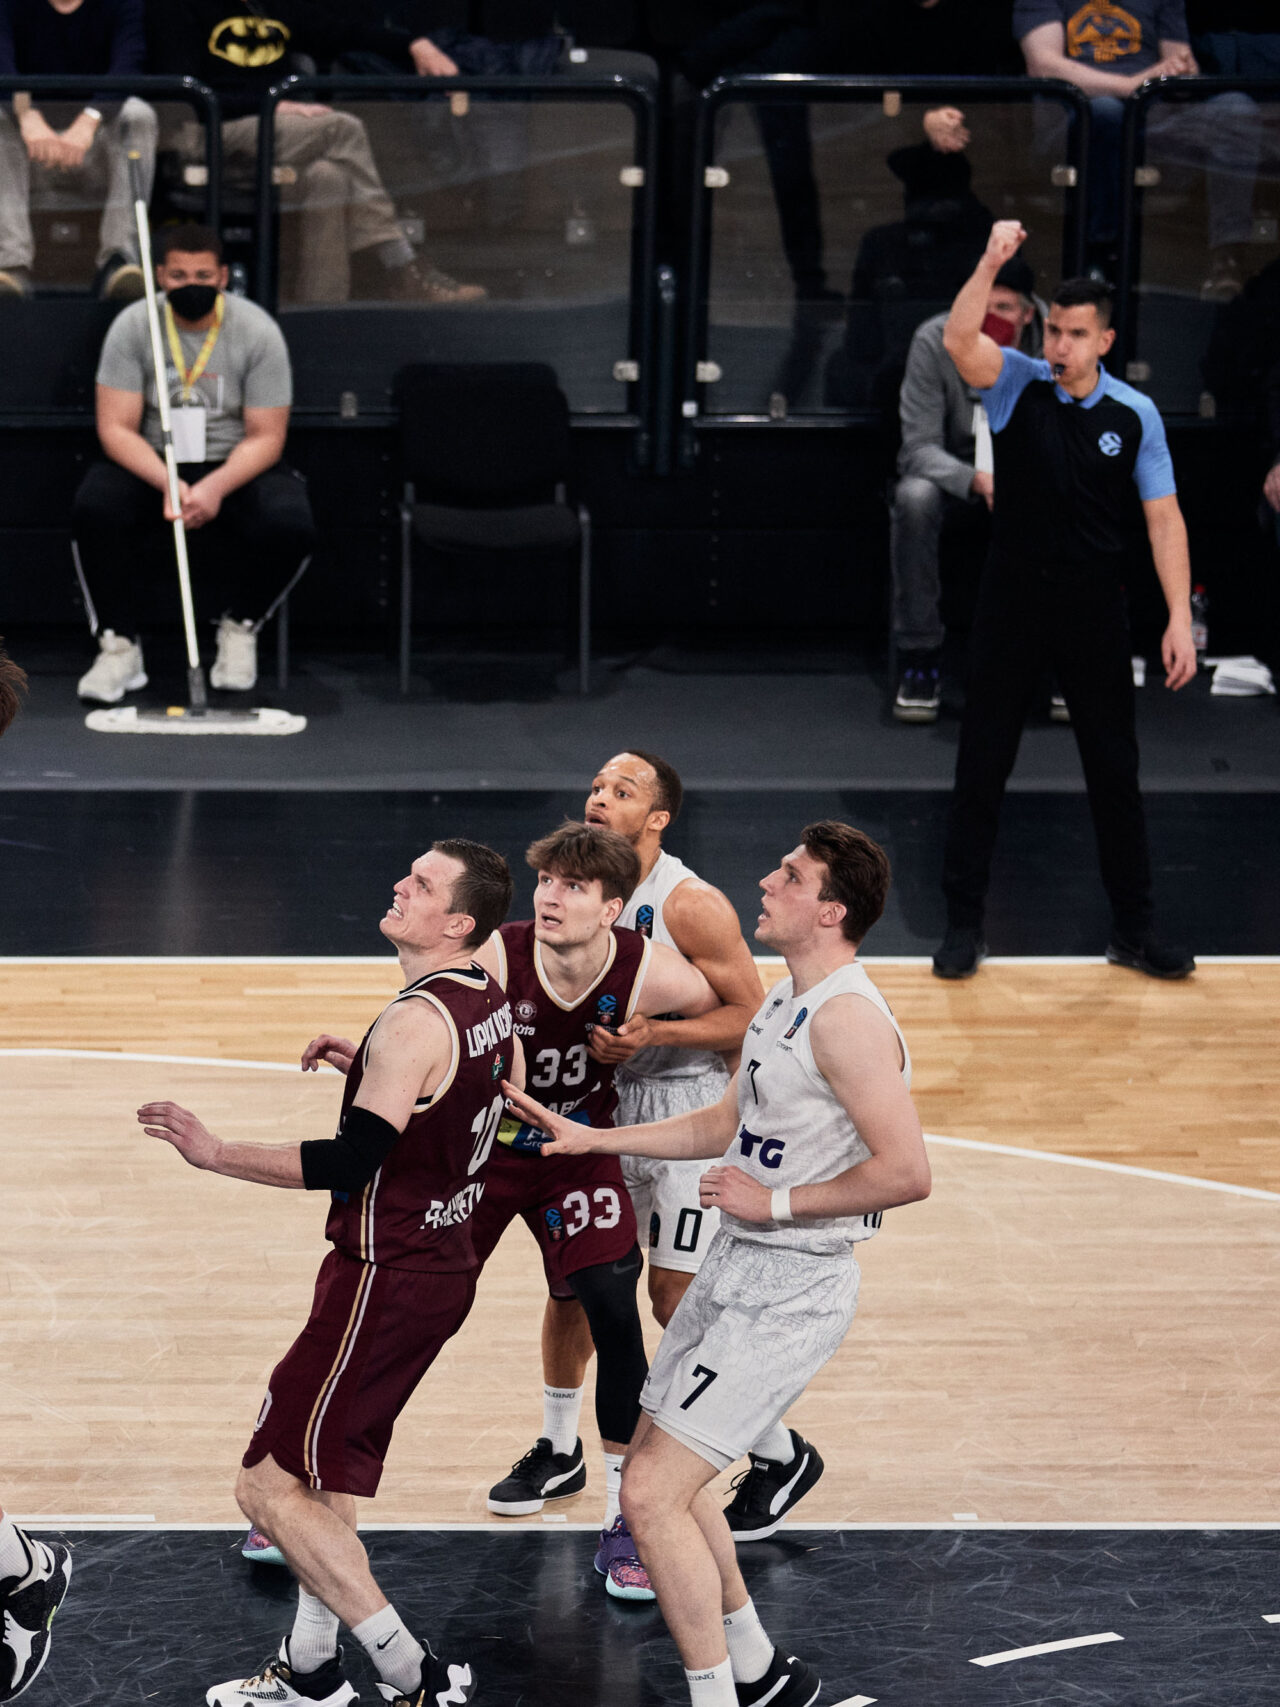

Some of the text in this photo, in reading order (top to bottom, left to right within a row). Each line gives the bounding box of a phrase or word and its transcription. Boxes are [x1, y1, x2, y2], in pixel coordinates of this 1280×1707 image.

[531, 1043, 588, 1088] 33
[746, 1058, 762, 1106] 7
[738, 1123, 786, 1169] TG
[562, 1186, 622, 1237] 33
[673, 1207, 703, 1253] 0
[680, 1363, 719, 1411] 7
